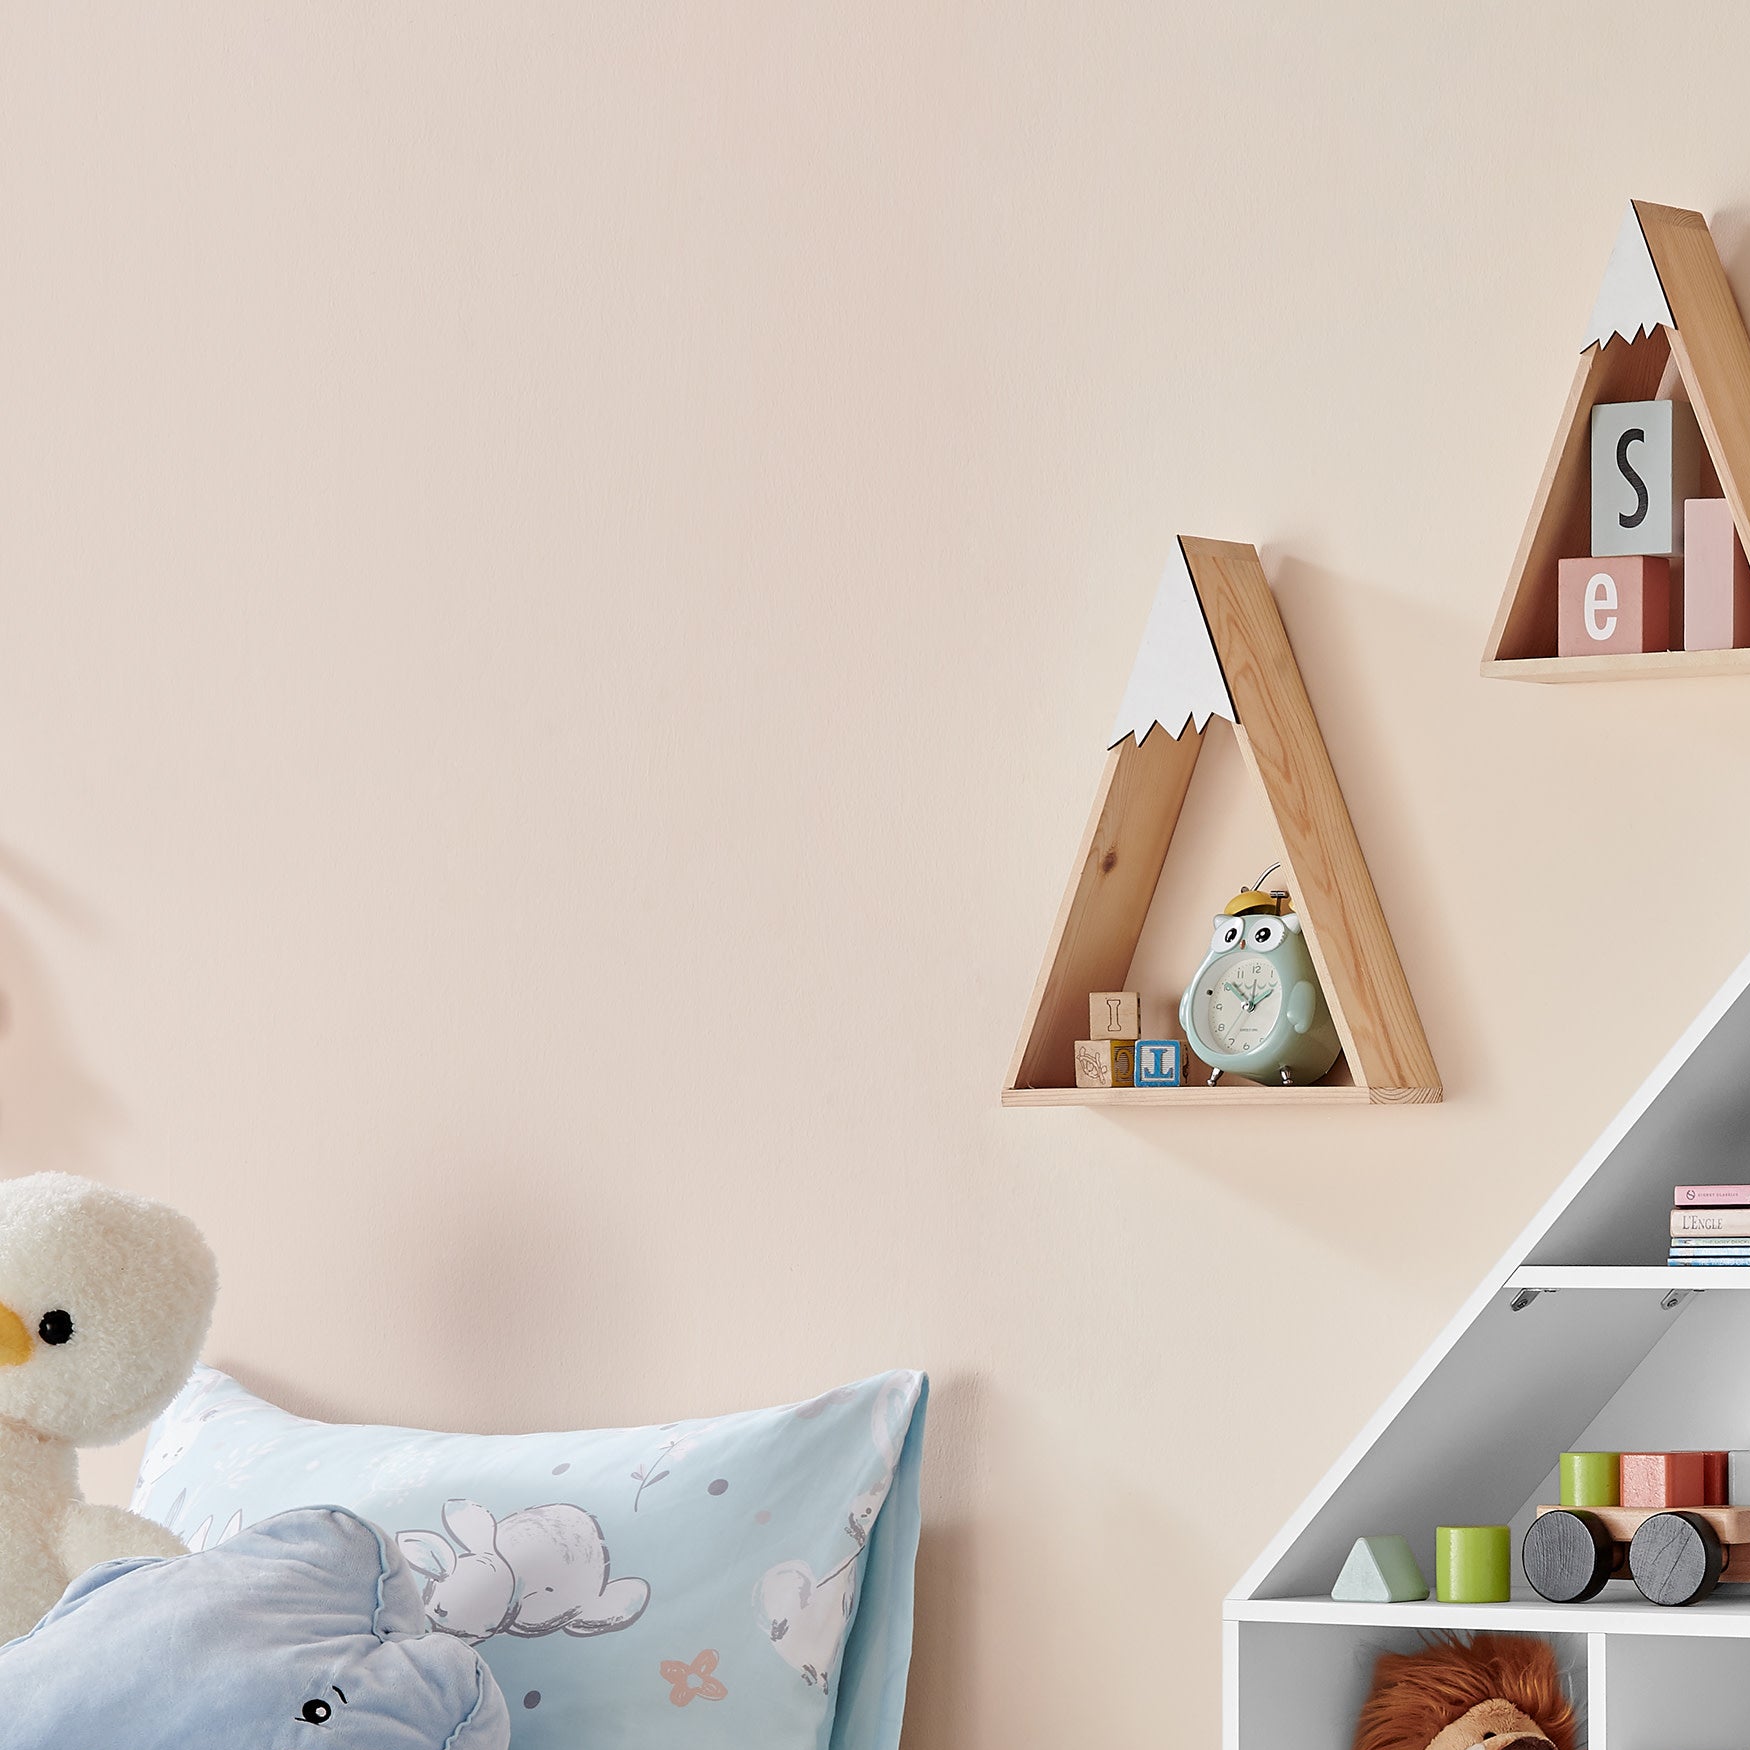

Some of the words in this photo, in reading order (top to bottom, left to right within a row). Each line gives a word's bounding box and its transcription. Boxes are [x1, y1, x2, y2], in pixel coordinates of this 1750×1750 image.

[1615, 428, 1649, 529] S
[1584, 573, 1618, 641] e
[1252, 965, 1261, 974] 12
[1144, 1048, 1174, 1078] T
